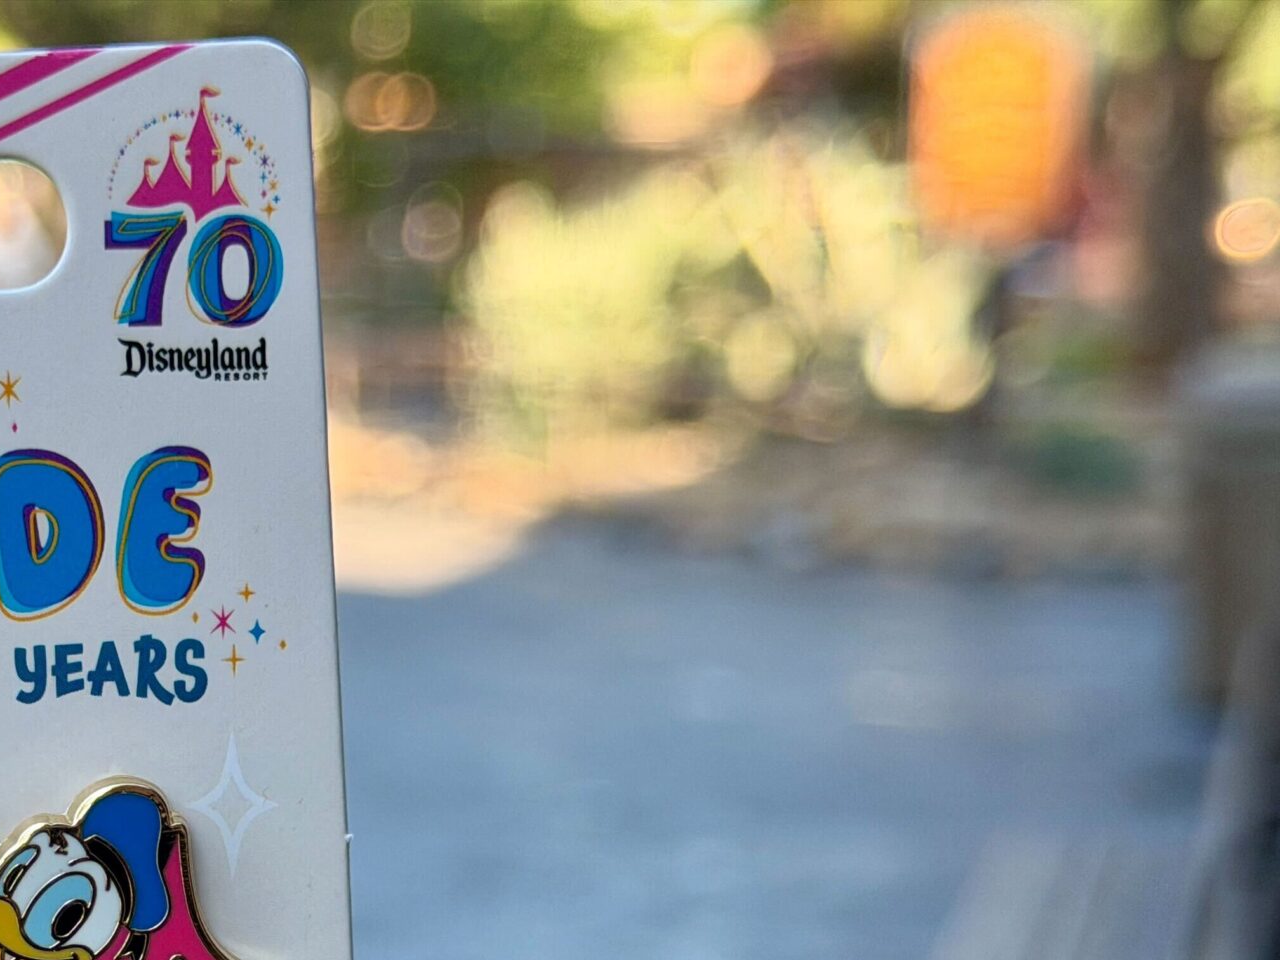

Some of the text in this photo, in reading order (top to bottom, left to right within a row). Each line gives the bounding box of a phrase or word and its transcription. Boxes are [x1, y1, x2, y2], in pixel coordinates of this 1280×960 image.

[104, 211, 284, 328] 70
[117, 337, 268, 379] Disneyland
[214, 371, 269, 381] RESORT
[14, 633, 209, 707] YEARS
